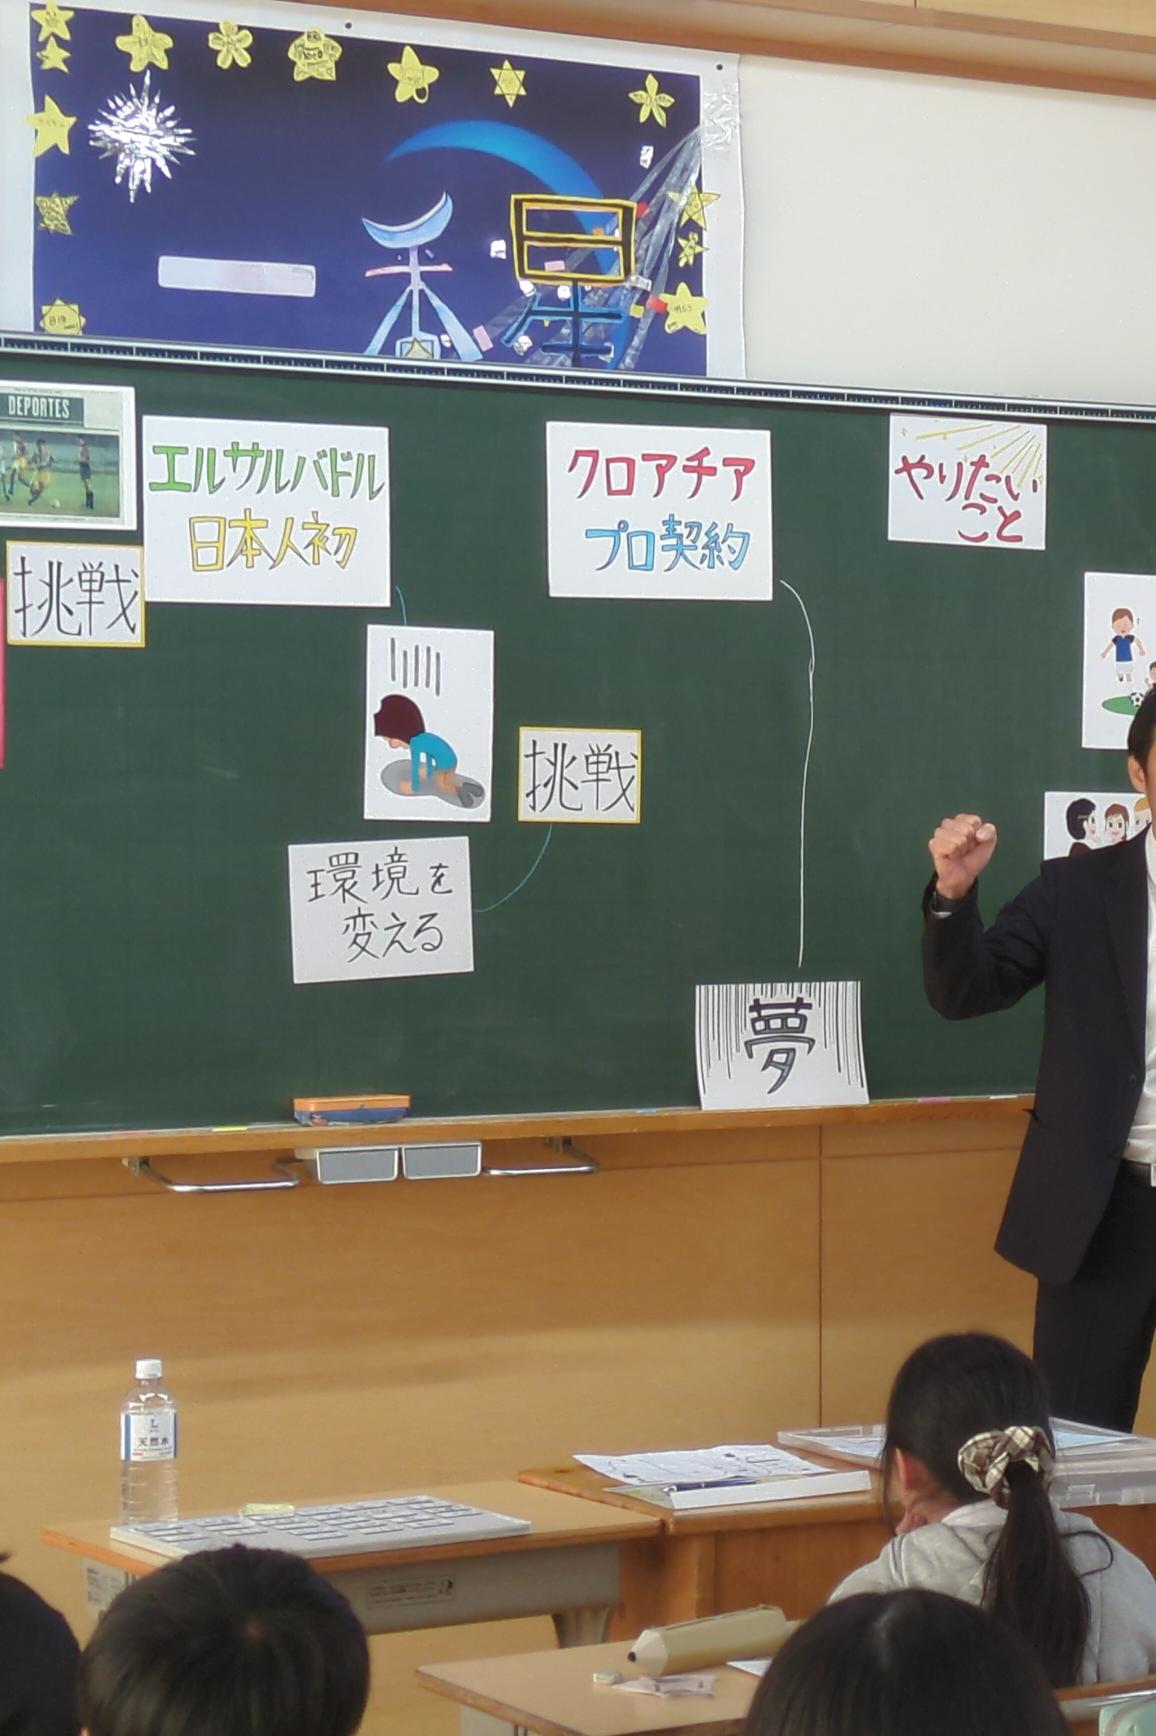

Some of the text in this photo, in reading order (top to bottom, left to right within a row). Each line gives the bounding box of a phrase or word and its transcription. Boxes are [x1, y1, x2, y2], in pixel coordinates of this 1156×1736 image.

[8, 395, 70, 418] DEPORTES
[148, 441, 386, 498] エルサルバドル
[567, 446, 757, 502] クロアチア
[894, 454, 1038, 503] やりたい
[188, 508, 358, 573] 日本人初
[584, 514, 751, 574] プロ契約
[957, 502, 1023, 543] こと
[13, 554, 139, 637] 挑戦
[523, 739, 639, 814] 挑戦
[306, 846, 454, 902] 環境を
[341, 911, 444, 964] 変える
[743, 997, 816, 1094] 夢
